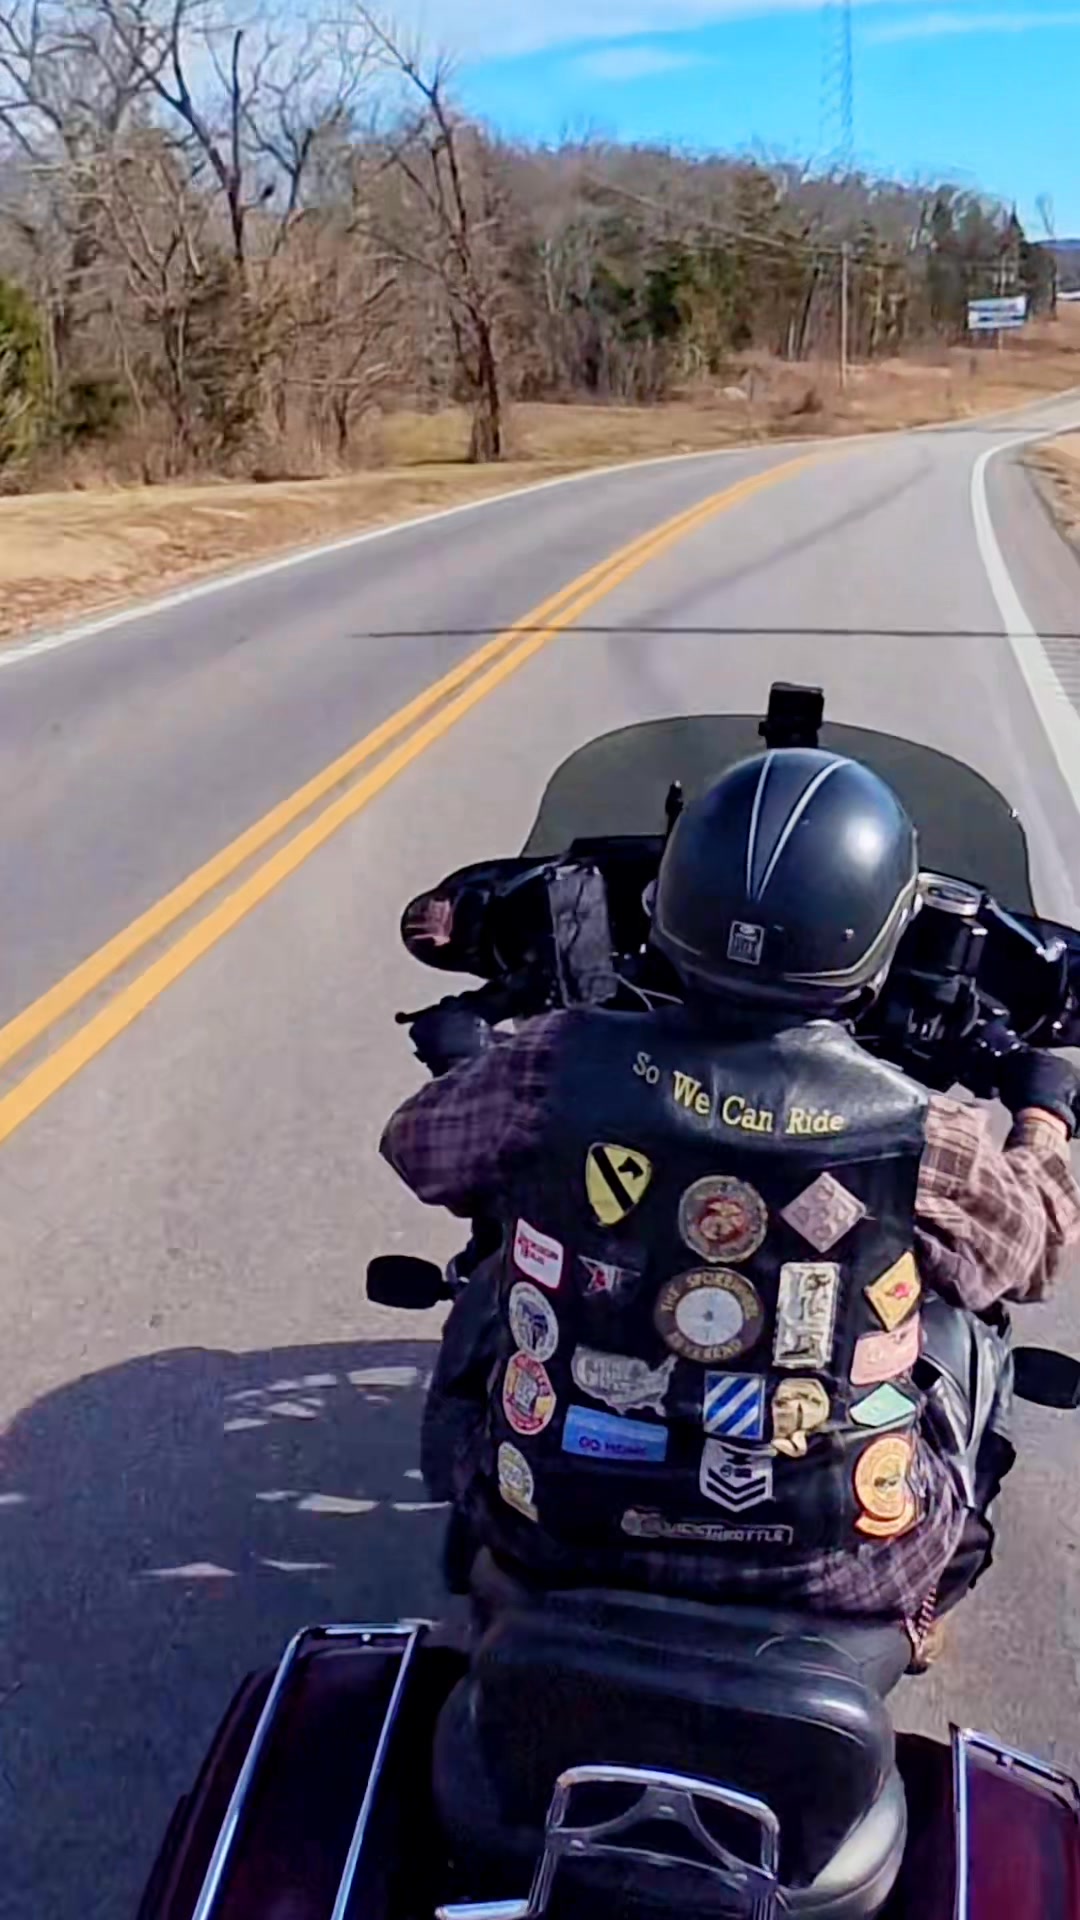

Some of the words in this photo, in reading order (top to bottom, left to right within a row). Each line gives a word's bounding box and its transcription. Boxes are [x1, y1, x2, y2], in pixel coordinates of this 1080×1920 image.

[632, 1051, 660, 1084] So
[673, 1070, 710, 1115] We
[722, 1095, 774, 1133] Can
[785, 1106, 845, 1135] Ride
